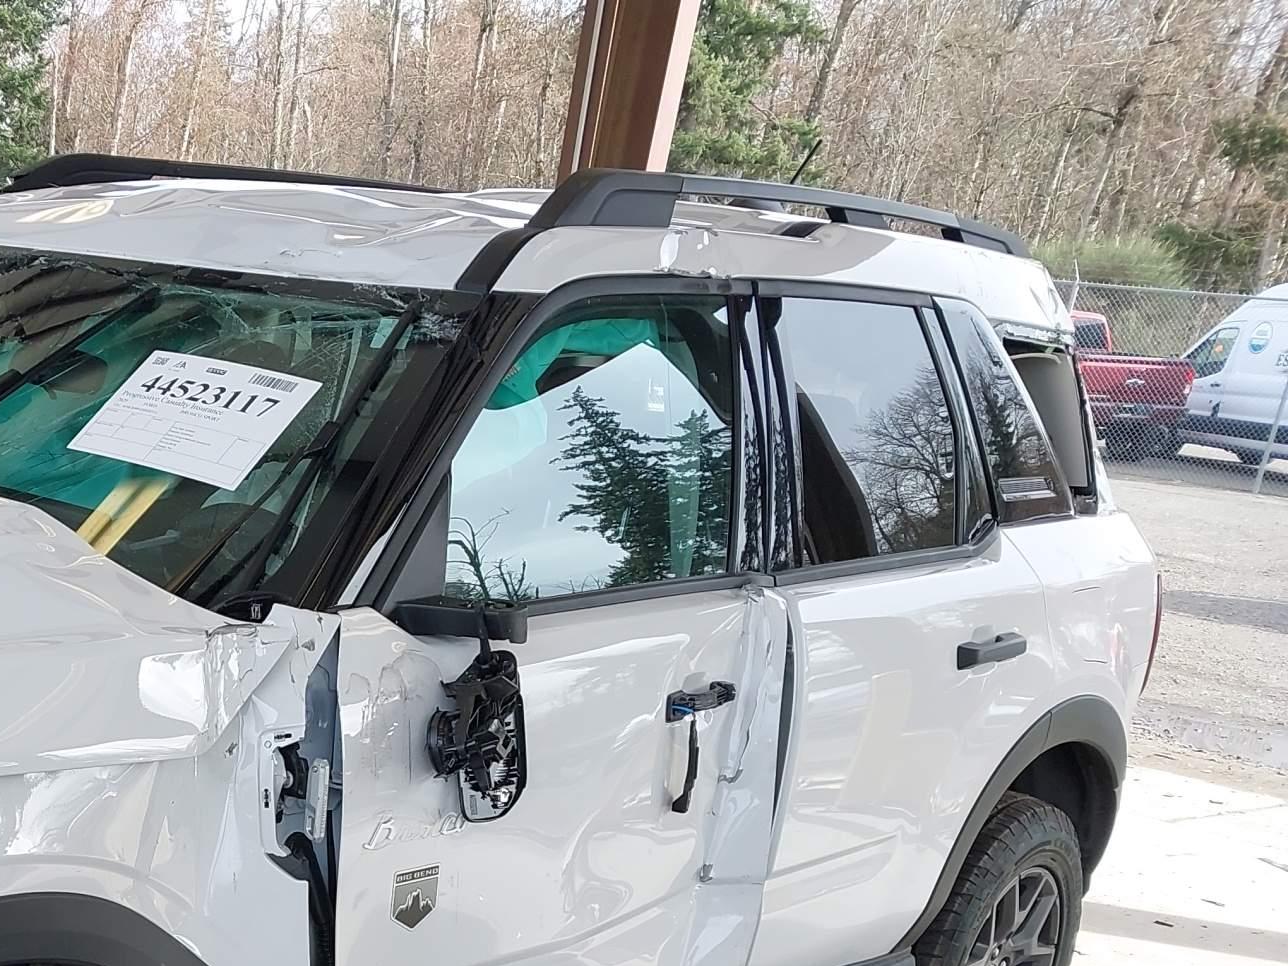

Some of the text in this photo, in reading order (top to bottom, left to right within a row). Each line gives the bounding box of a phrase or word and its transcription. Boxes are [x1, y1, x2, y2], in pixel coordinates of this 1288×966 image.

[141, 374, 281, 417] 44523117
[396, 867, 439, 883] BIG BEND
